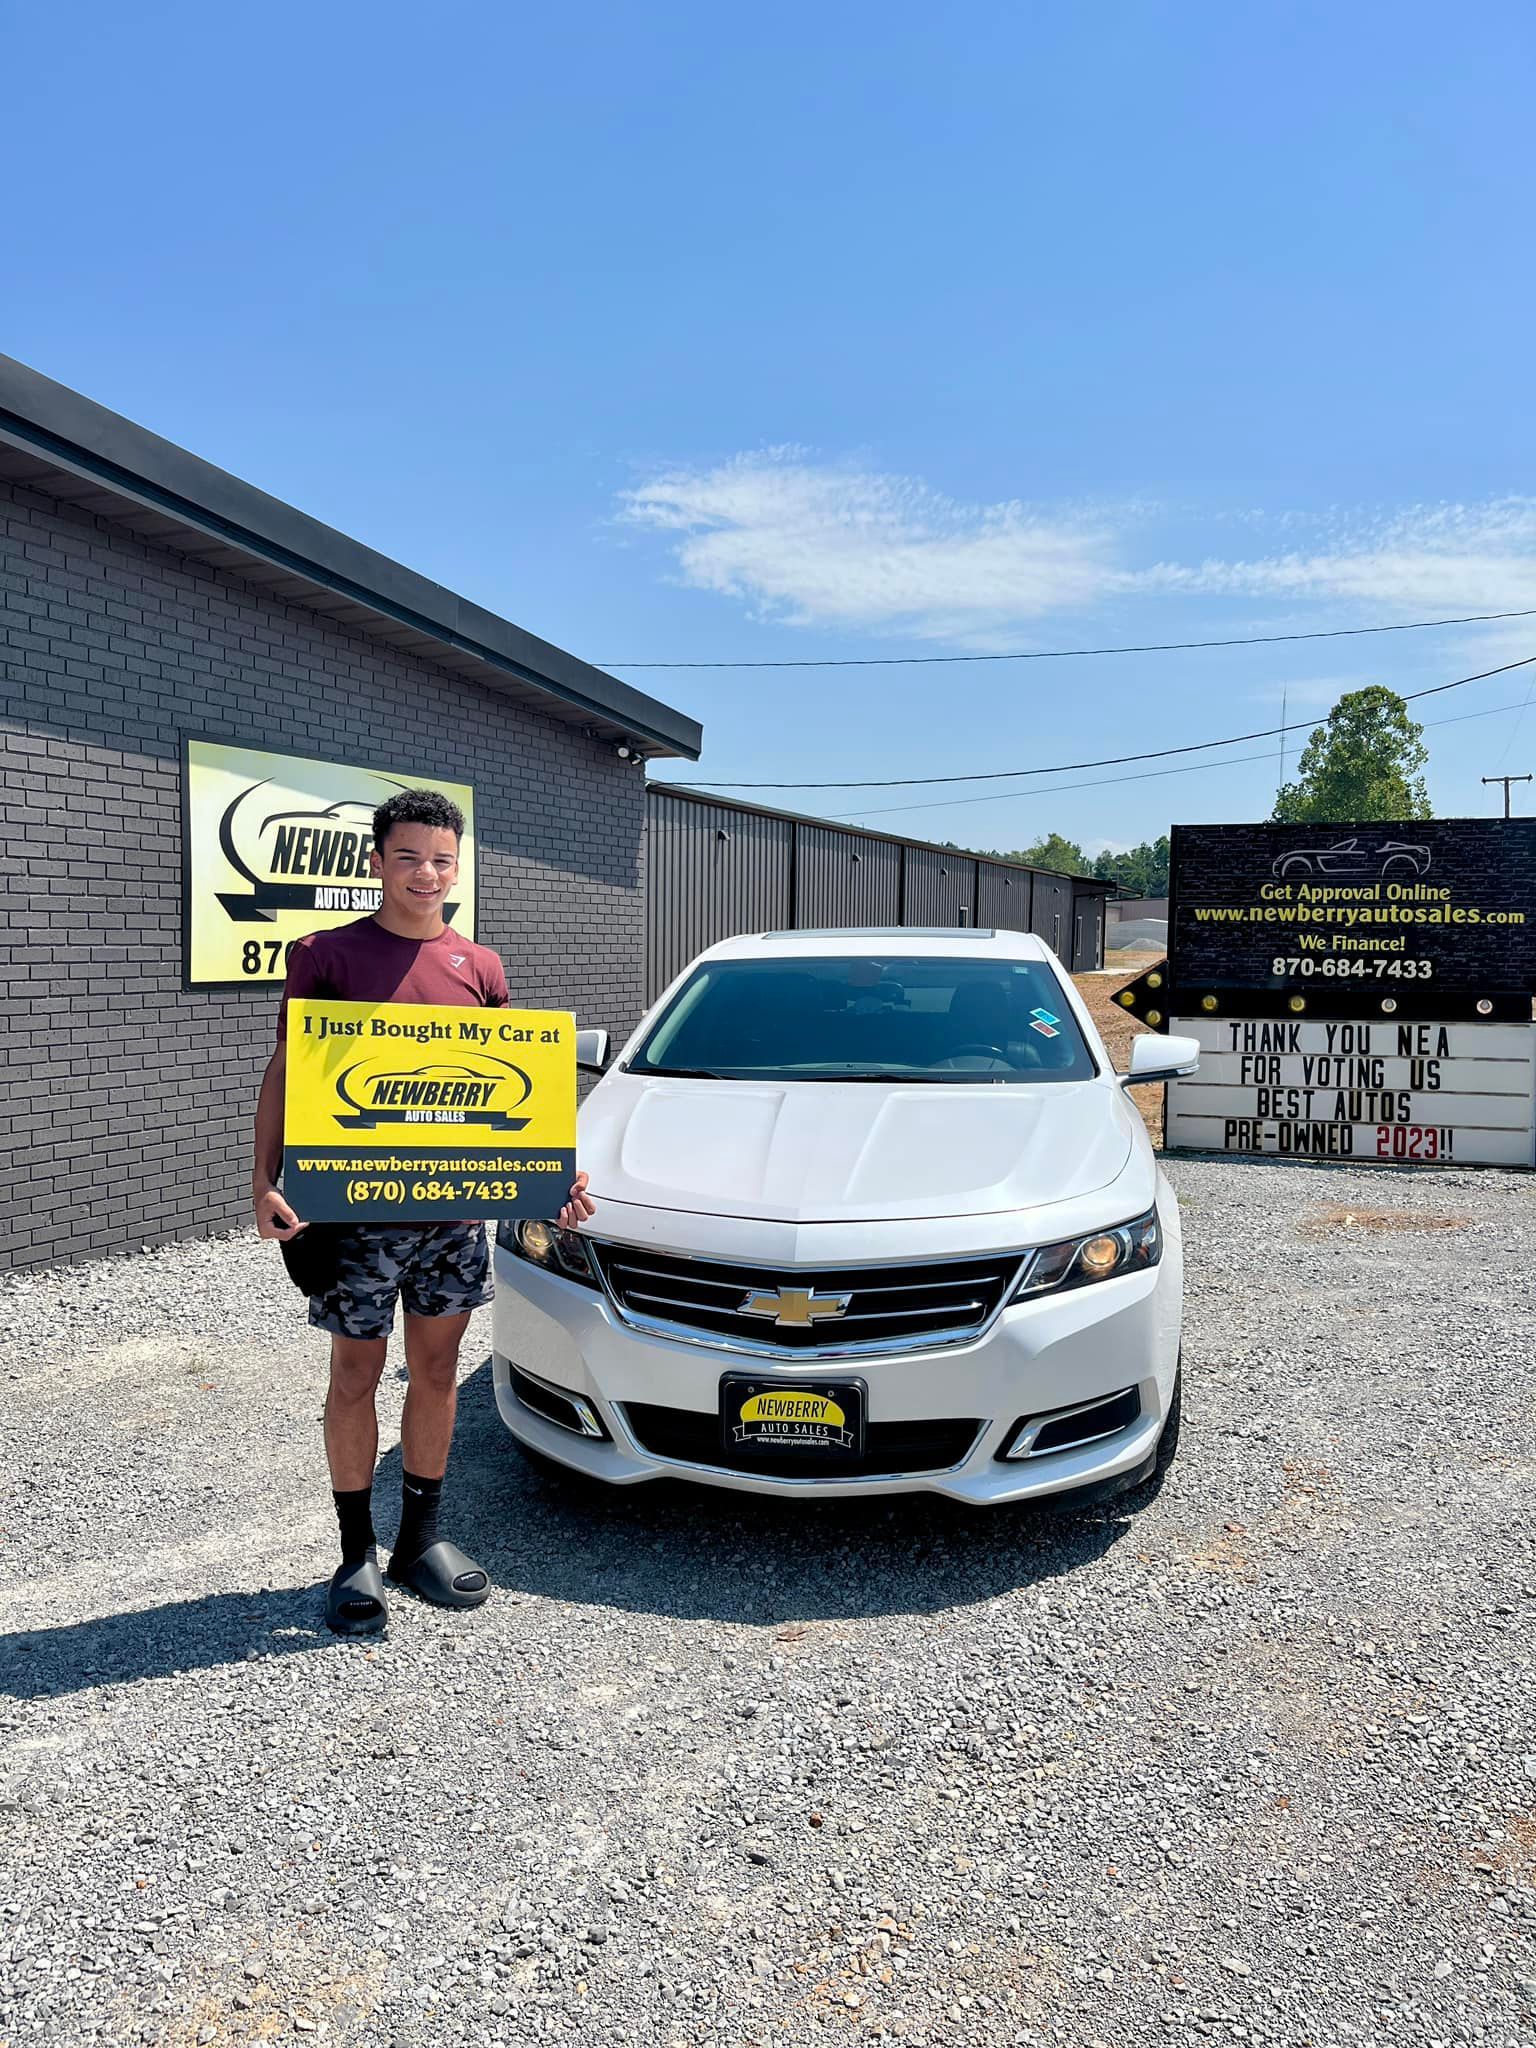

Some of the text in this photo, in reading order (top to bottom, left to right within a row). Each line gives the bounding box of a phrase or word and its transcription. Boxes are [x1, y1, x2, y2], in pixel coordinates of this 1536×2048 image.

[270, 825, 375, 878] NEWBE
[314, 887, 349, 909] AUTO
[1260, 884, 1451, 903] Get Approval Online
[1195, 904, 1525, 926] www.newberryautosales.com
[1299, 935, 1406, 951] We Finance!
[242, 940, 295, 974] 87
[1272, 958, 1433, 979] 870-684-7433
[304, 1016, 560, 1046] I Just Bought My Car at
[1229, 1023, 1450, 1057] THANK YOU NEA
[1240, 1056, 1441, 1090] FOR VOTING US
[371, 1080, 497, 1107] NEWBERRY
[405, 1111, 466, 1123] AUTO SALES
[1257, 1089, 1411, 1122] BEST AUTOS
[1224, 1119, 1453, 1160] PRE-OWNED 2023!!
[297, 1156, 562, 1176] www.newberryautosales.com
[346, 1180, 518, 1204] (870) 684-7433
[757, 1398, 829, 1418] NEWBERRY
[761, 1423, 828, 1436] AUTO SALES
